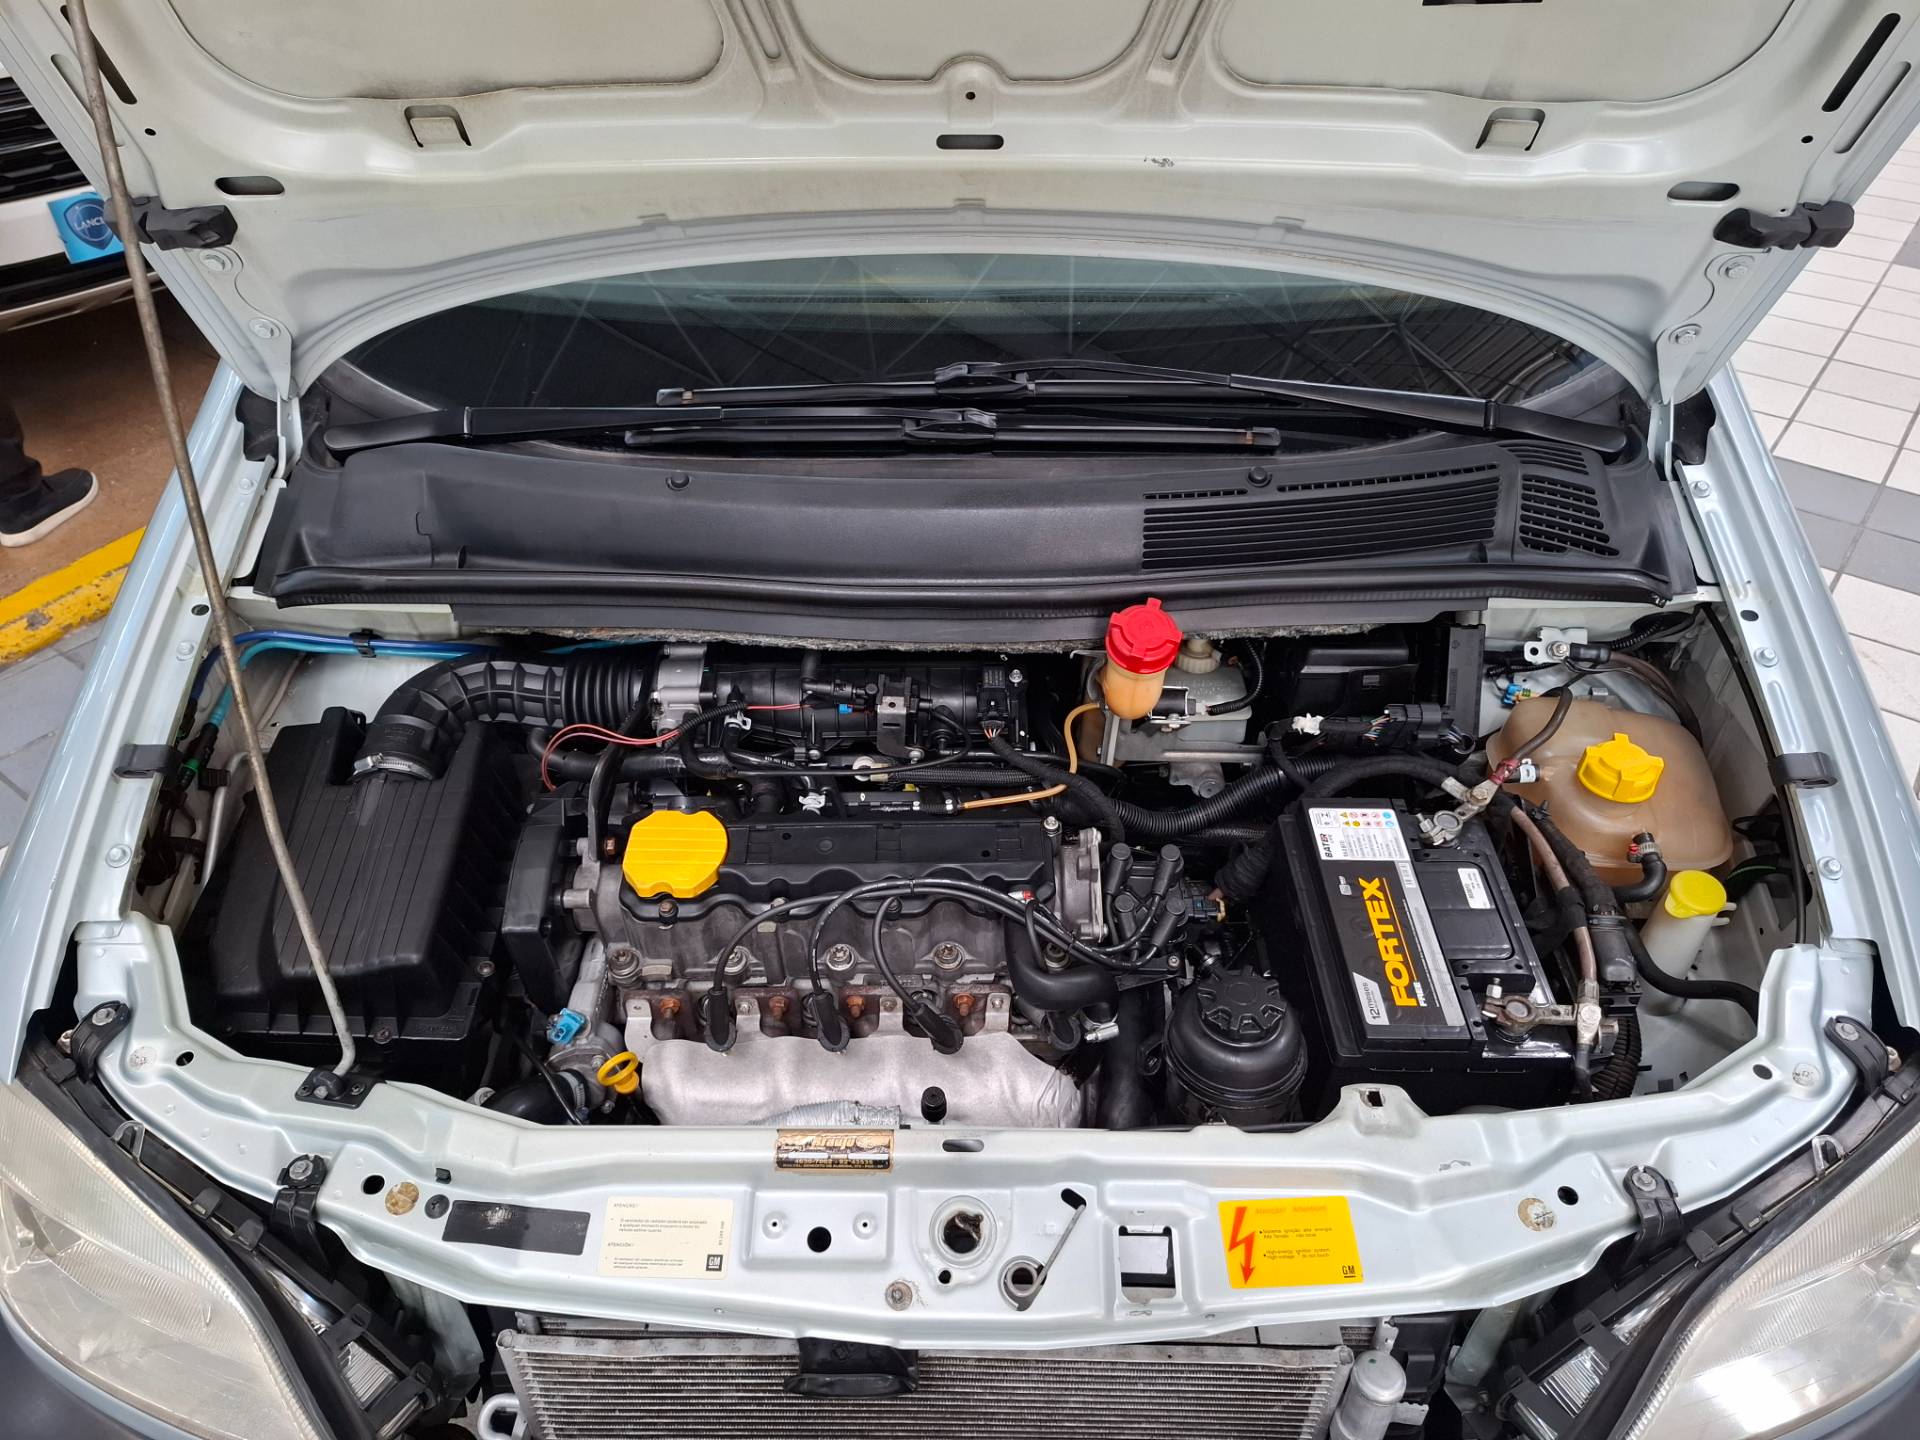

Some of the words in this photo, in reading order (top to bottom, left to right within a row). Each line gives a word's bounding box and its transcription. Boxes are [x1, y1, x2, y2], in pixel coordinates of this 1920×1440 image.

[1358, 876, 1418, 1007] FORTEX
[1413, 981, 1428, 1007] FREE
[708, 1256, 721, 1267] GM
[1341, 1265, 1356, 1275] GM
